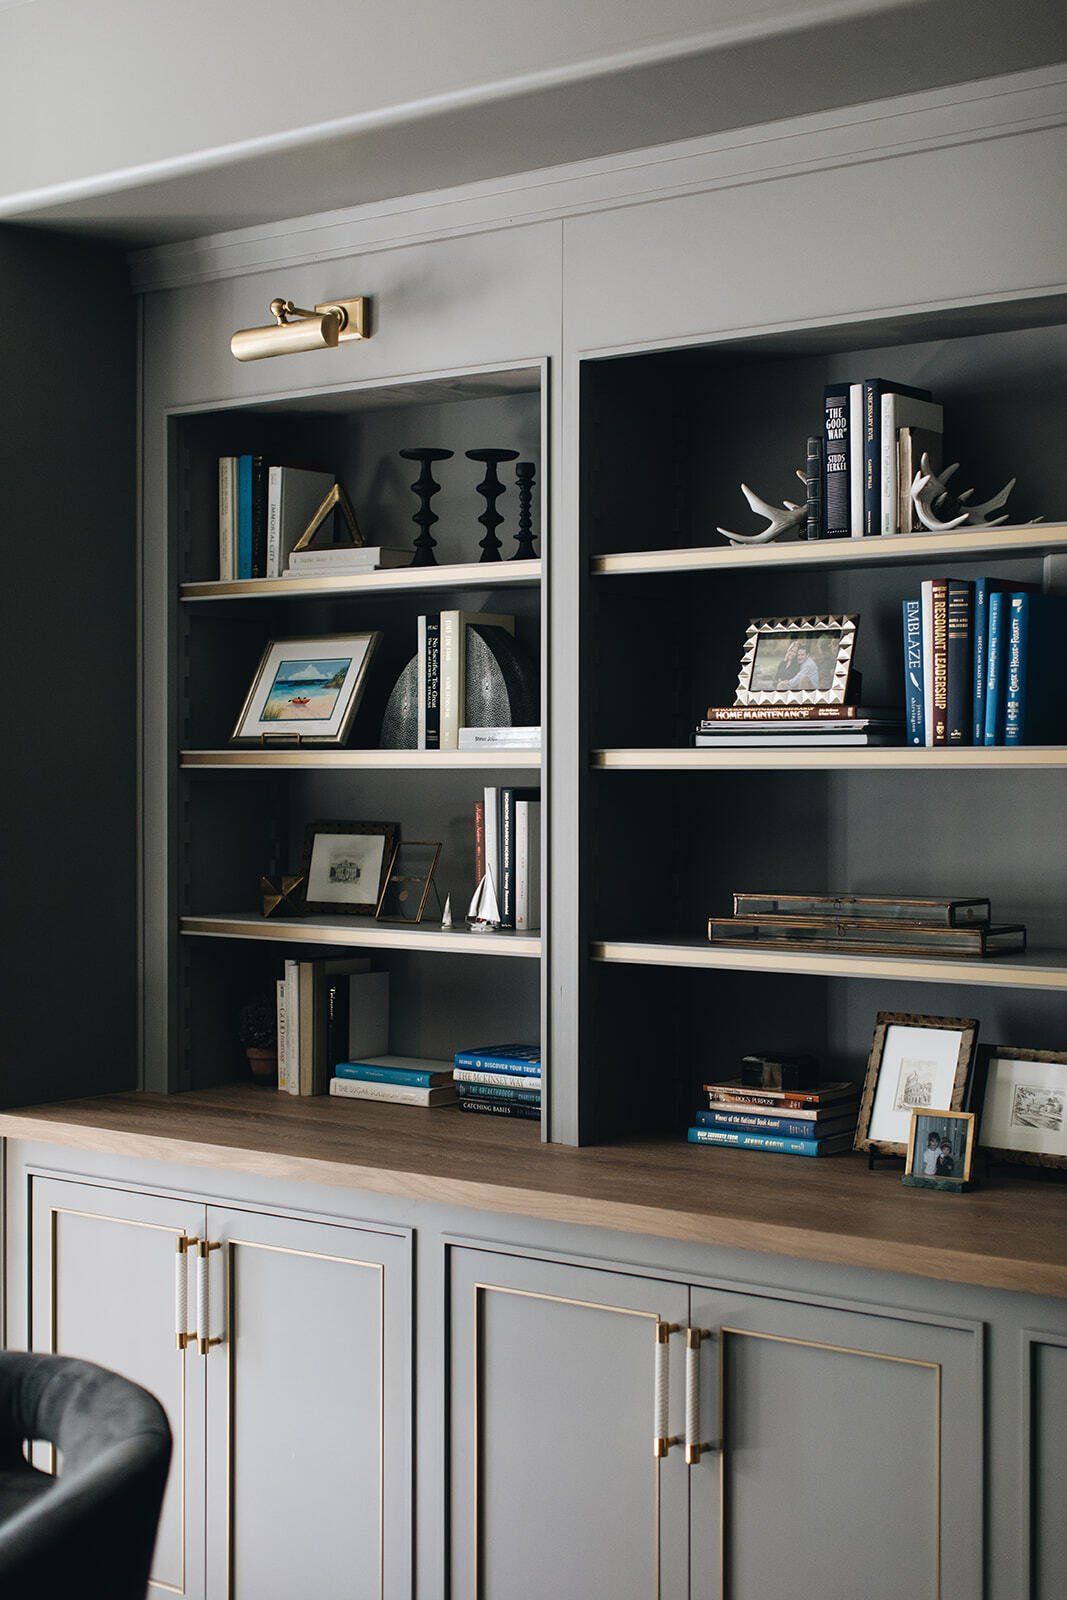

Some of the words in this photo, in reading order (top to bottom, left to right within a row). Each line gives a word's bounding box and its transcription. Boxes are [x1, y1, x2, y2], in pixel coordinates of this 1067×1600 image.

[826, 418, 846, 429] GOOD
[828, 454, 845, 463] STUDS
[934, 602, 946, 649] RESONANT
[907, 602, 920, 668] EMBLAZE
[432, 638, 438, 648] No
[934, 652, 948, 710] LEADERSHIP
[716, 710, 743, 720] HOME
[744, 710, 808, 720] MAINTENANCE
[458, 1072, 470, 1080] THE
[479, 1087, 514, 1097] BREAKTHROUGH
[752, 1097, 774, 1105] PURPOSE
[463, 1102, 492, 1111] CATCHING
[715, 1114, 728, 1122] Winner
[740, 1116, 756, 1125] National
[757, 1118, 766, 1126] Book
